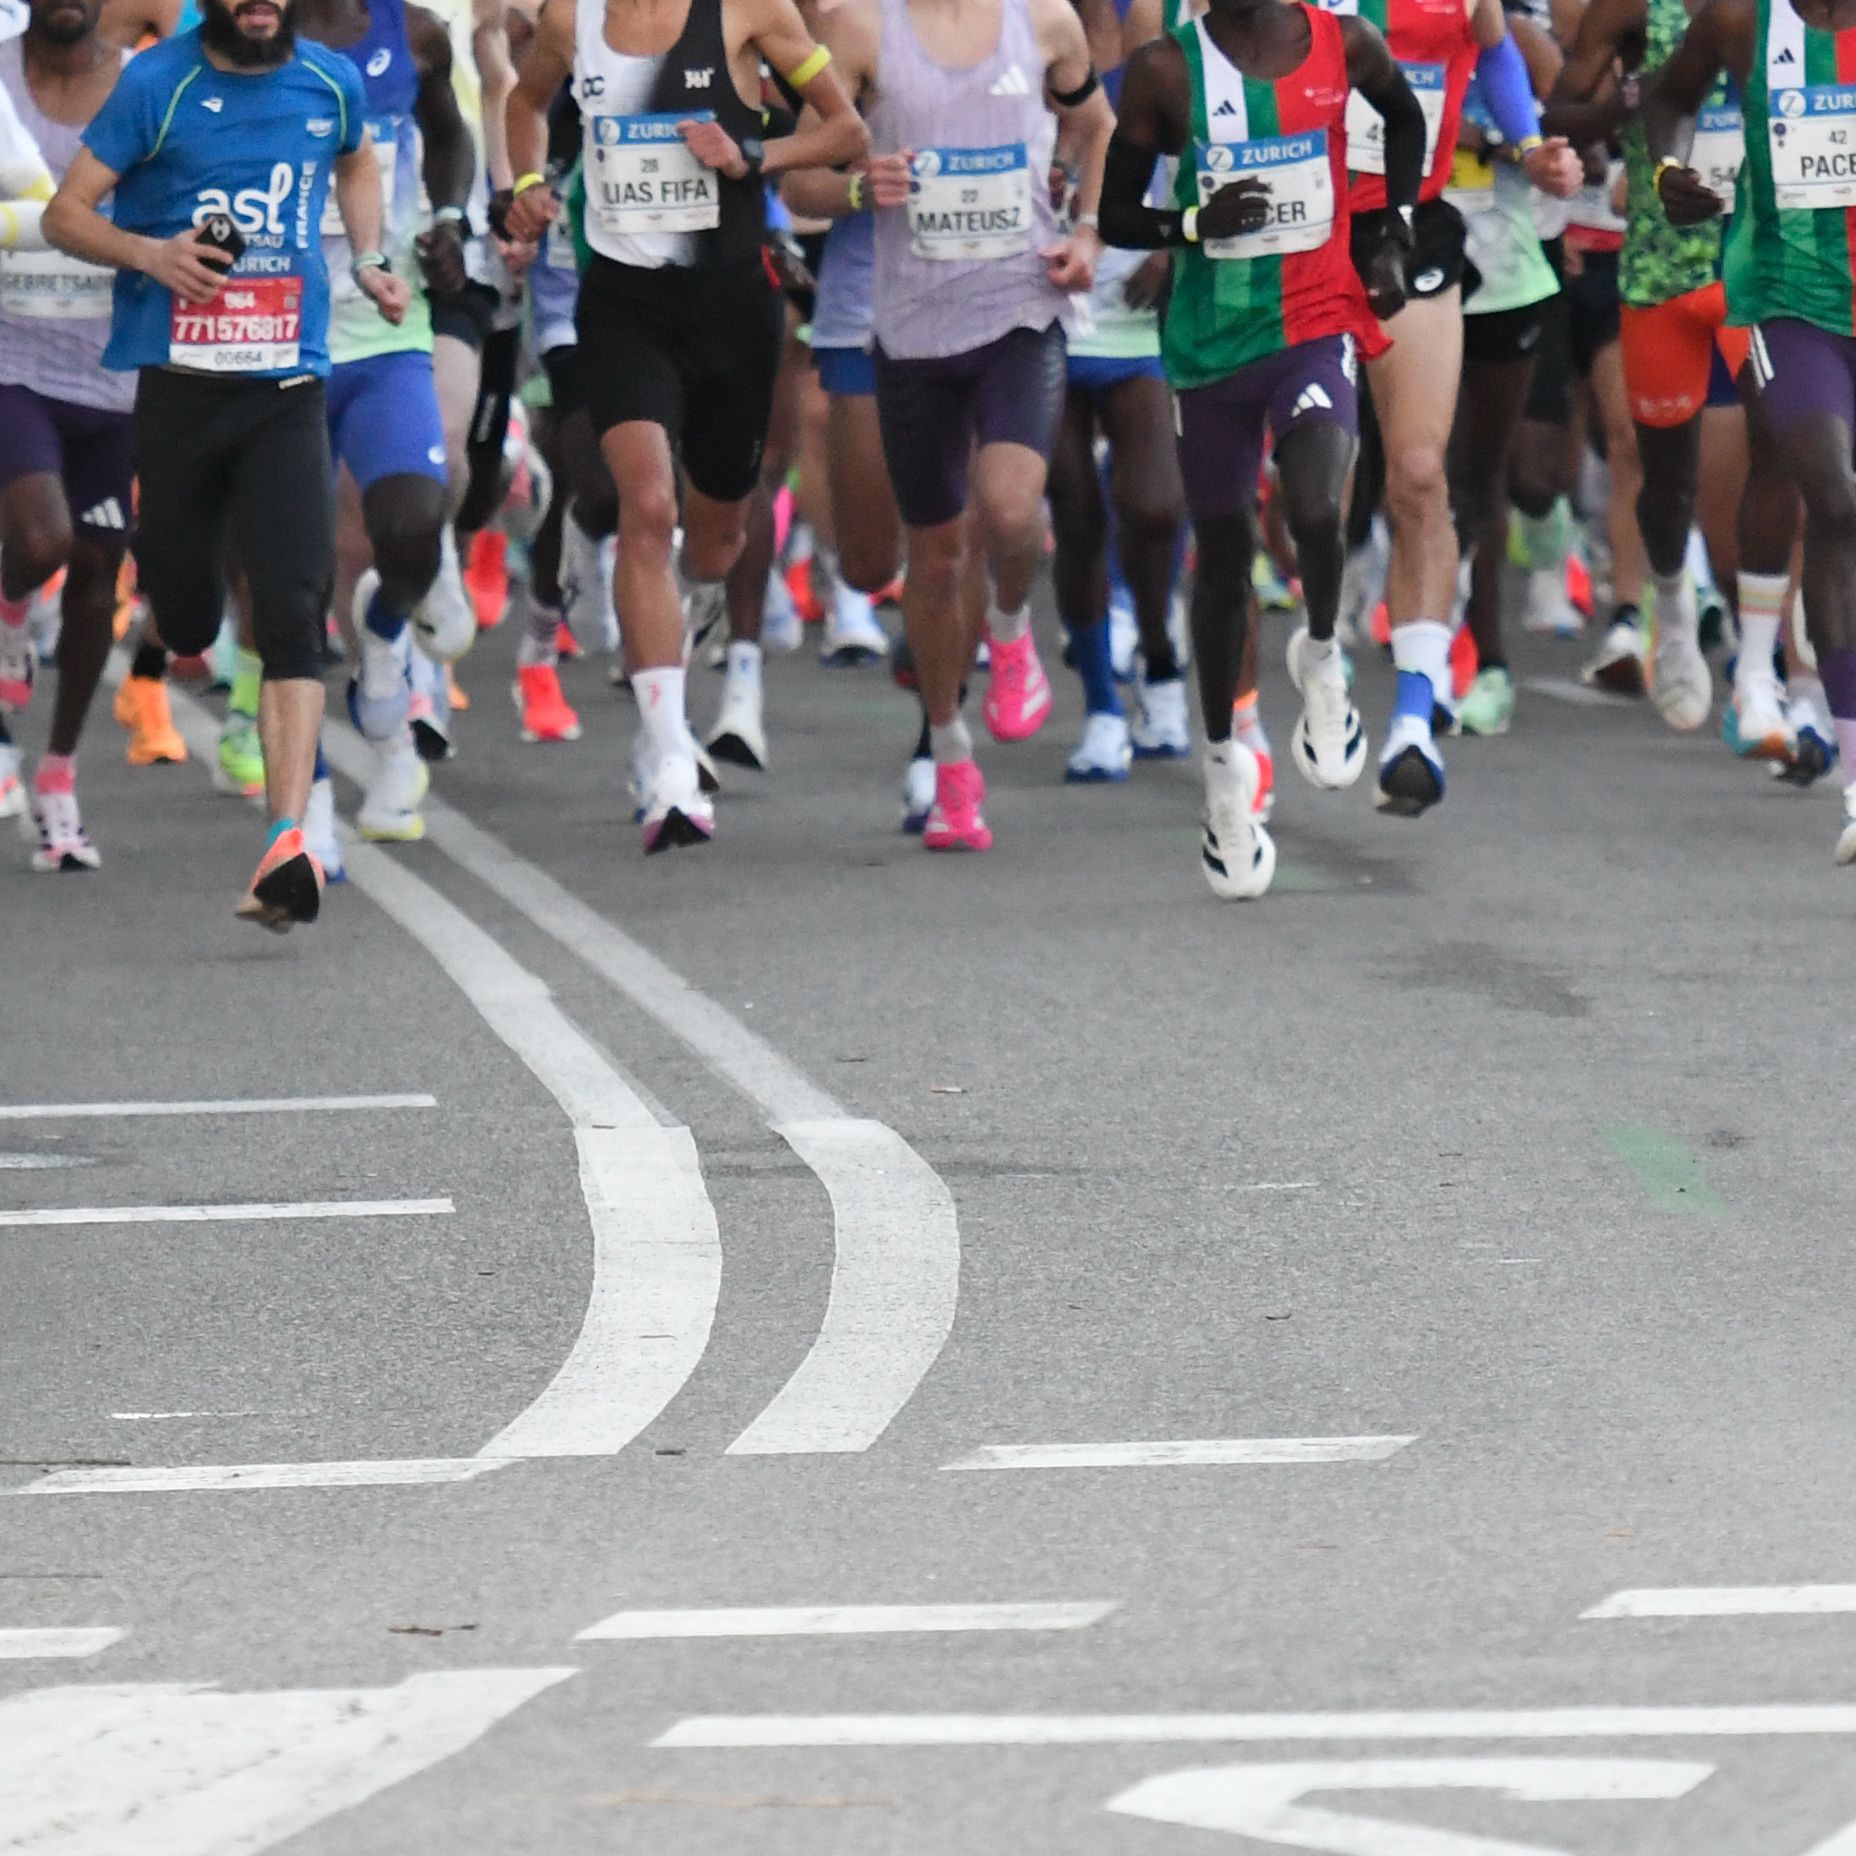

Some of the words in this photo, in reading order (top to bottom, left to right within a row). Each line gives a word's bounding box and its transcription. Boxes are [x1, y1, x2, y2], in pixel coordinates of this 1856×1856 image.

[948, 150, 1016, 173] ZURICH
[1241, 139, 1313, 166] ZURICH
[660, 178, 710, 203] FIFA
[916, 206, 1022, 232] MATEUSZ
[232, 256, 292, 273] URICH
